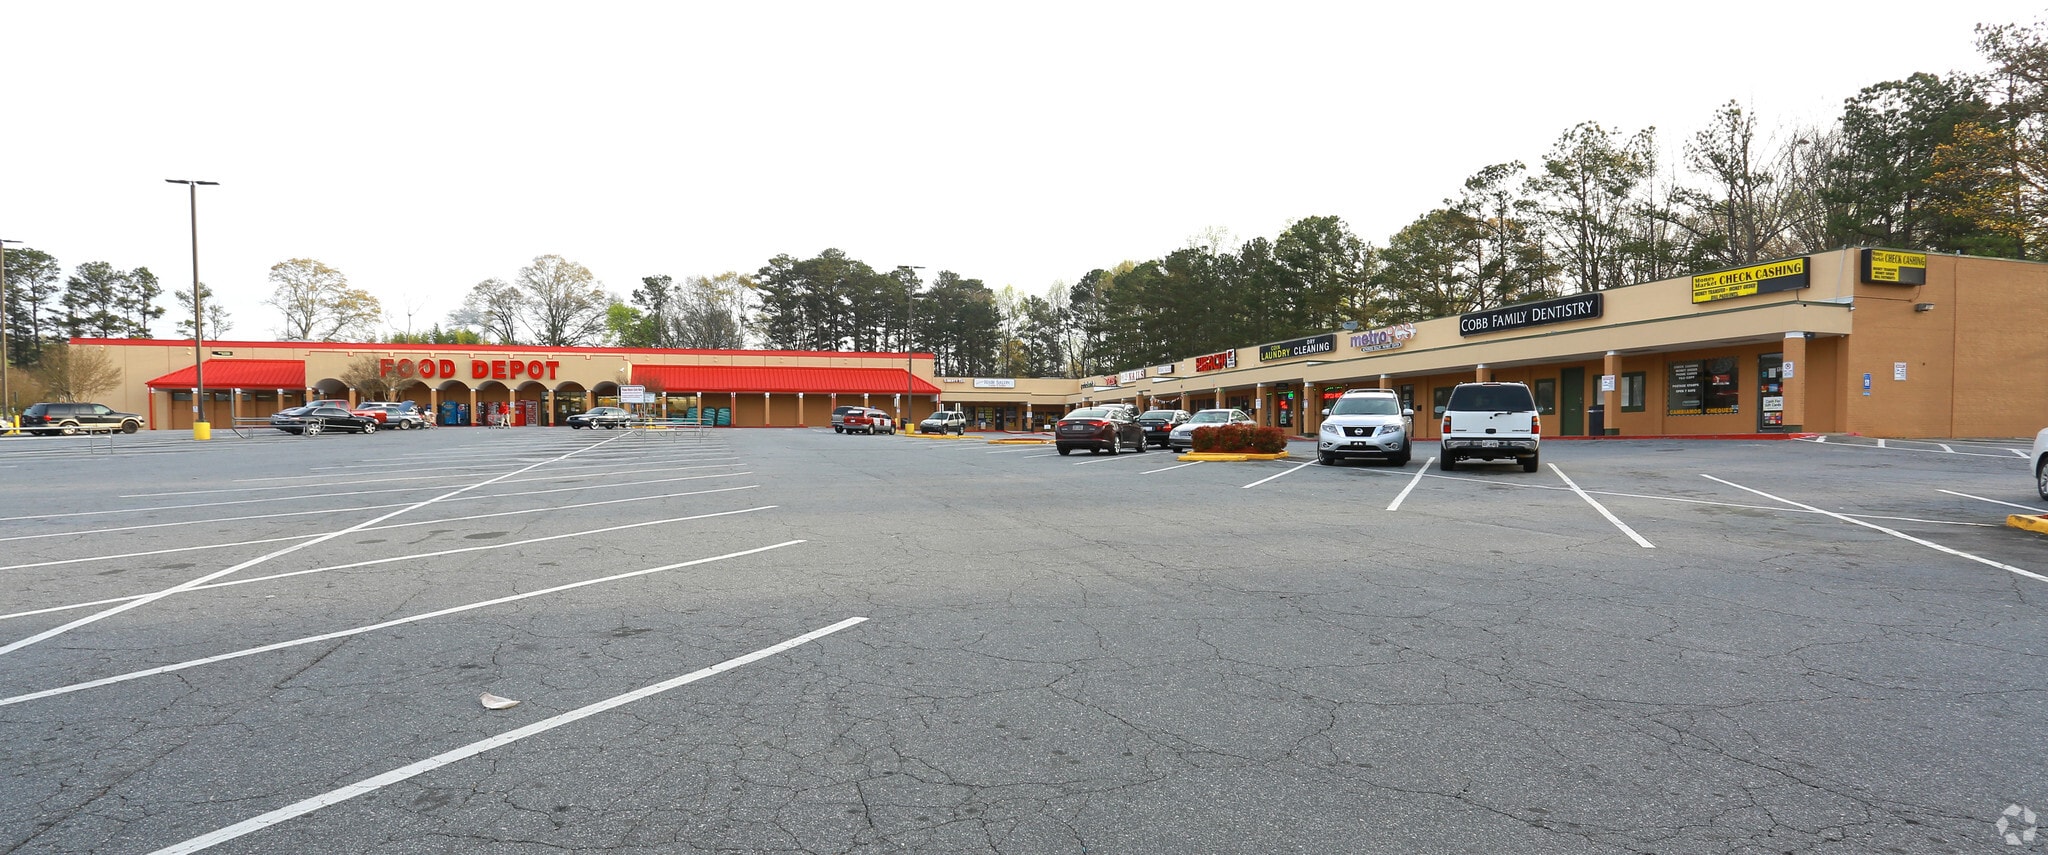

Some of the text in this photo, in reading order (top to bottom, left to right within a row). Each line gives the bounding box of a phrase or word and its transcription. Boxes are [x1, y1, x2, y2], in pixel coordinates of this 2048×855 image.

[1885, 254, 1925, 266] CHECK CASHING
[1720, 262, 1801, 285] CHECK CASHING
[1695, 280, 1717, 288] Market
[1708, 286, 1726, 294] TRANSFER
[1461, 300, 1593, 332] COBB FAMILY DENTISTRY
[1350, 322, 1413, 348] metroPCS
[1261, 342, 1330, 360] LAUNDRY CLEANING
[379, 358, 560, 380] FOOD DEPOT
